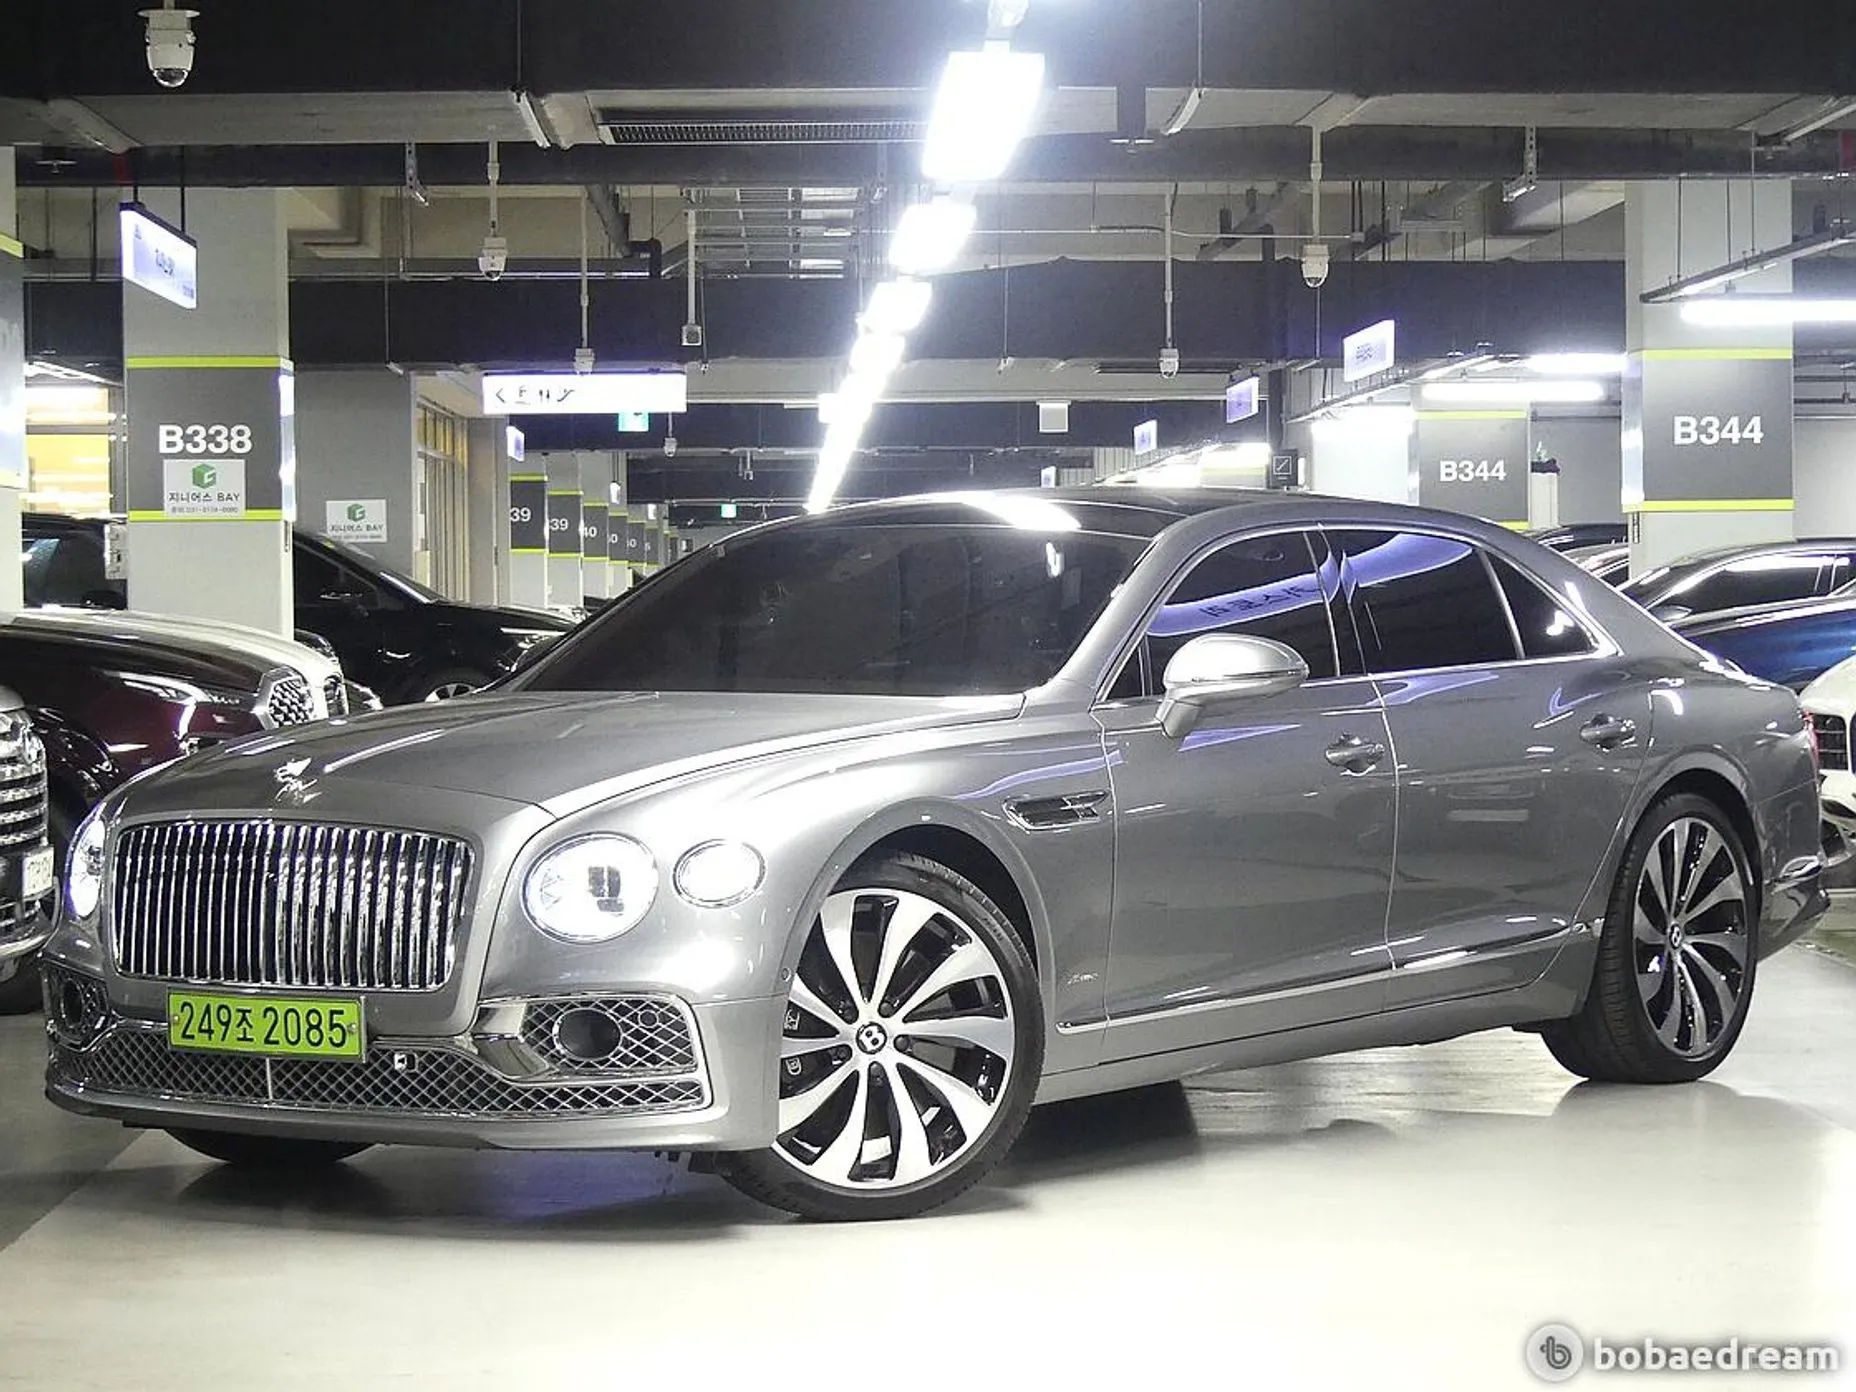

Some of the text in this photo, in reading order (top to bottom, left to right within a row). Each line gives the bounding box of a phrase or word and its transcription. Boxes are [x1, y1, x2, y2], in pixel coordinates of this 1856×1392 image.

[159, 424, 252, 454] B338
[1673, 415, 1764, 445] B344
[1439, 459, 1507, 482] B344
[168, 492, 240, 503] 지니어스 BAY
[180, 1001, 347, 1048] 249조 2085
